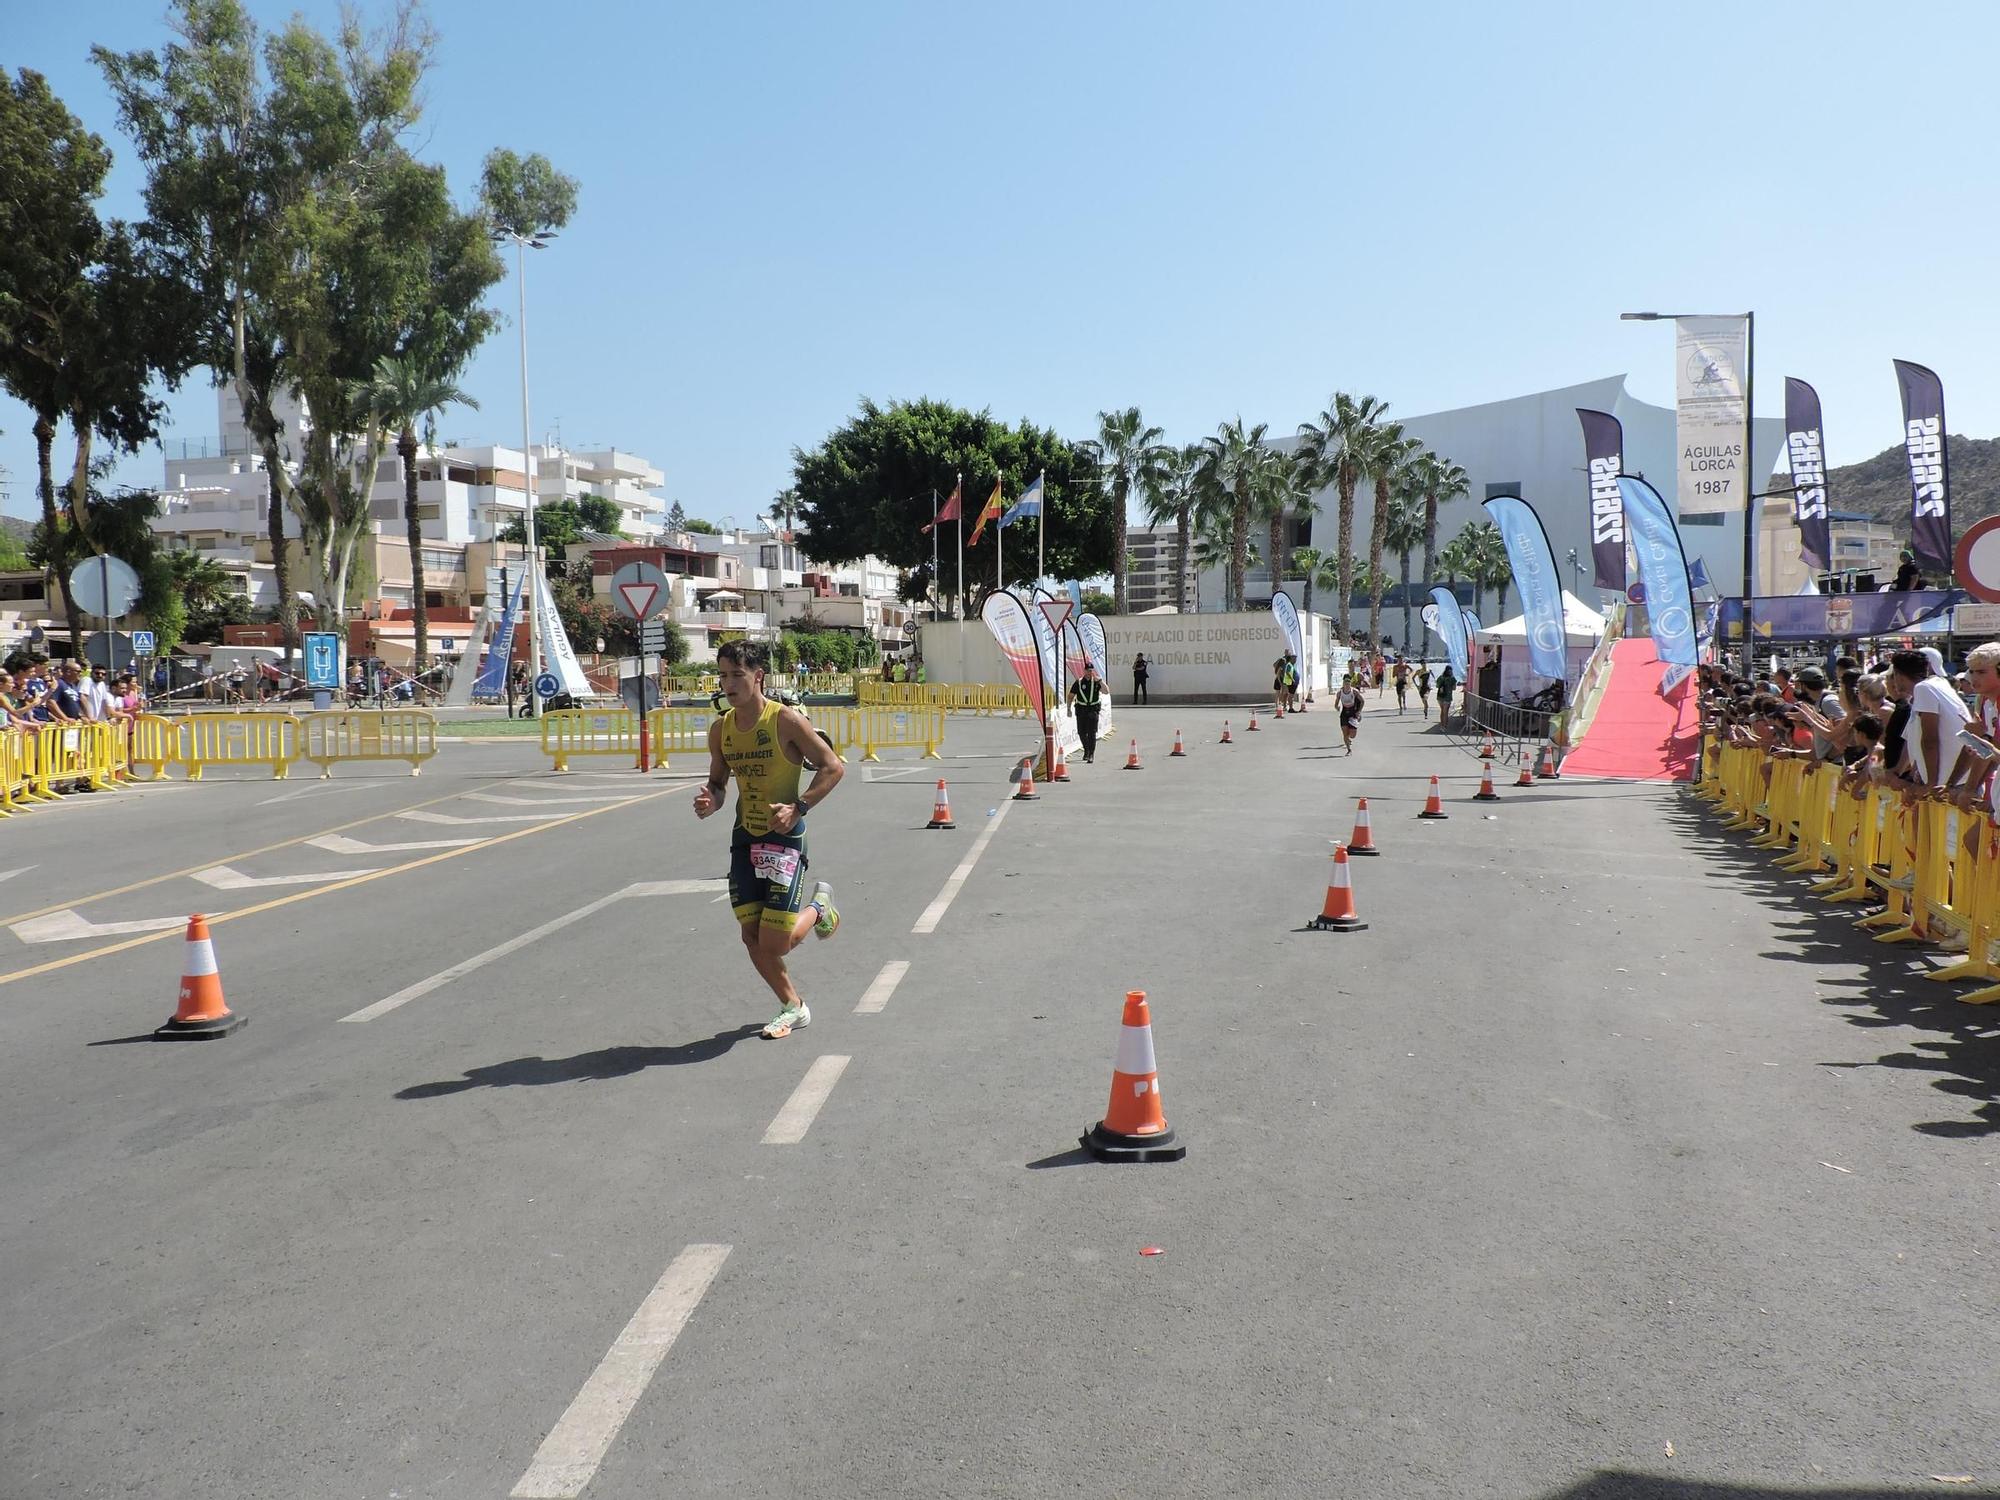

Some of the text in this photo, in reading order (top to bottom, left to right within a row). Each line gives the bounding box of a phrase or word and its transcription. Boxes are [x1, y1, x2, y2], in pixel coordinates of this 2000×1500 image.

[1684, 445, 1742, 459] ÁGUILAS
[1690, 459, 1736, 472] LORCA
[1694, 480, 1731, 494] 1987
[1124, 631, 1132, 644] Y
[1136, 630, 1184, 644] PALACIO
[1188, 629, 1204, 643] DE
[1207, 627, 1280, 642] CONGRESOS
[1157, 651, 1190, 666] DOÑA
[1194, 651, 1231, 665] ELENA
